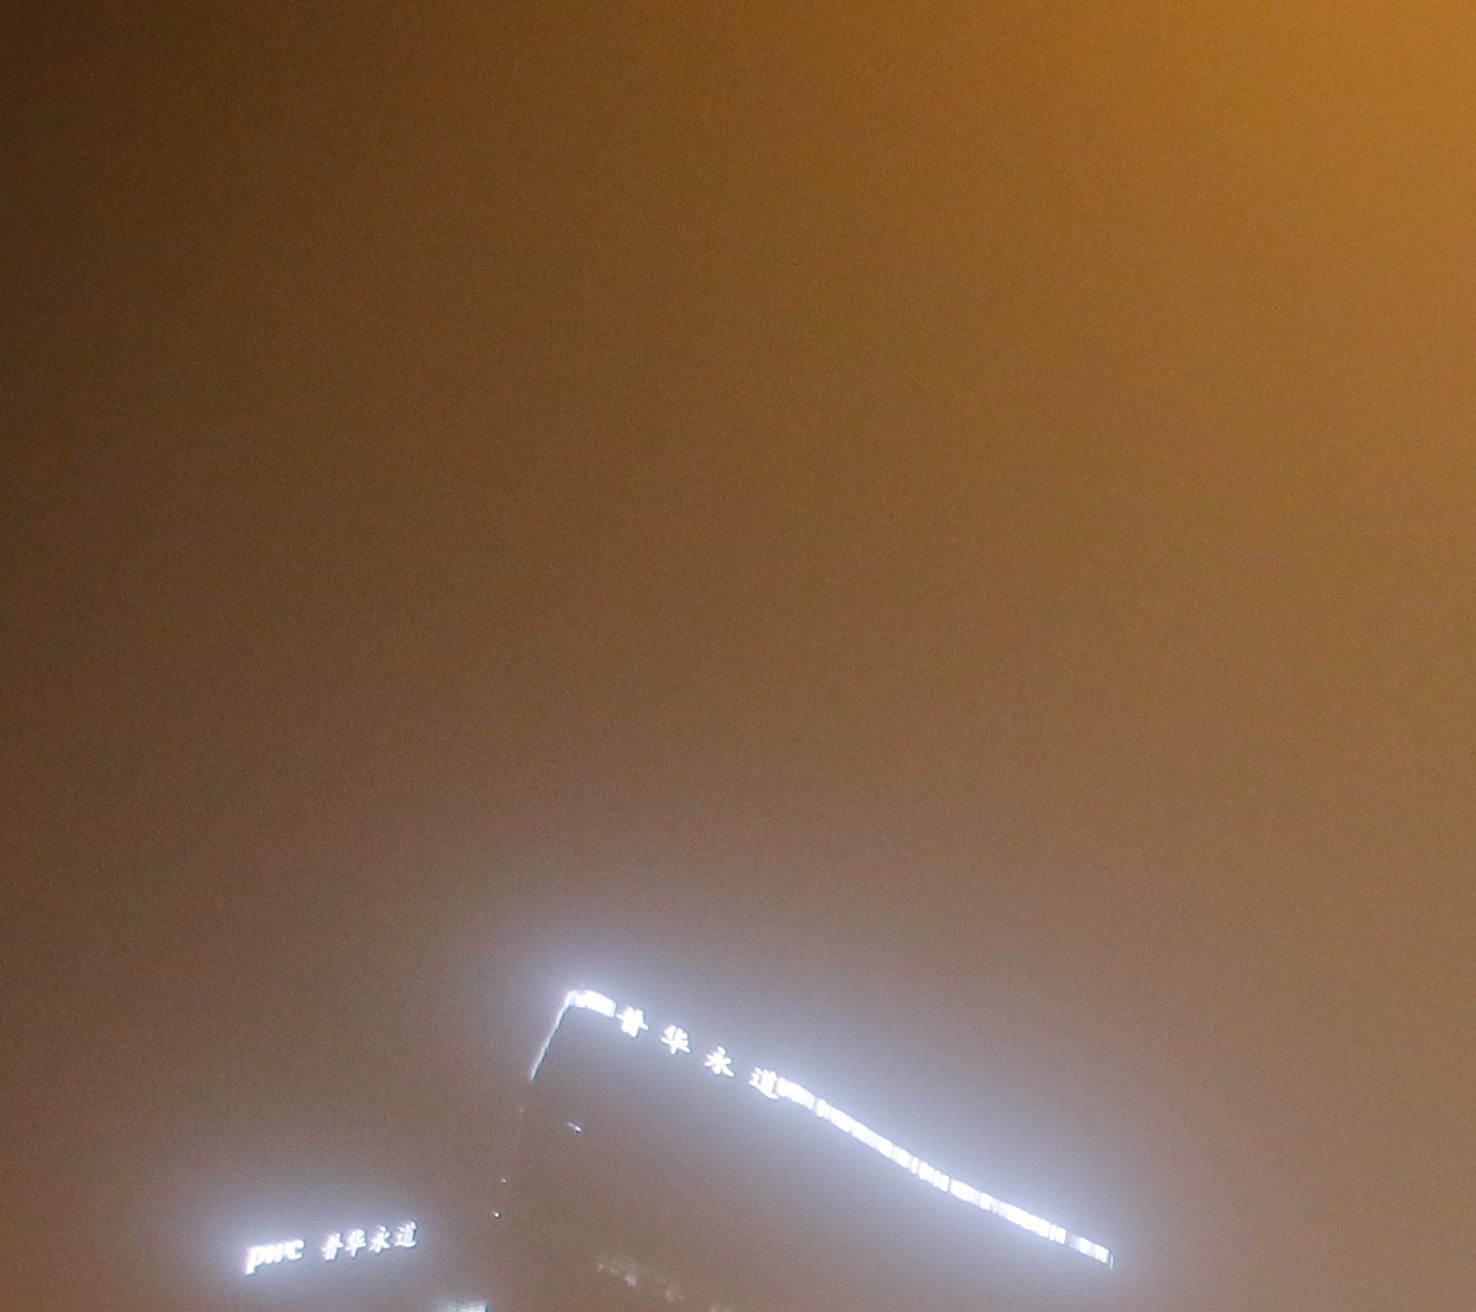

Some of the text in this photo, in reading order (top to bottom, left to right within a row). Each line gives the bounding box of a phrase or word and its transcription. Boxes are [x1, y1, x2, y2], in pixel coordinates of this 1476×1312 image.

[617, 1005, 779, 1099] 普华永道
[321, 1221, 417, 1260] 普华永道
